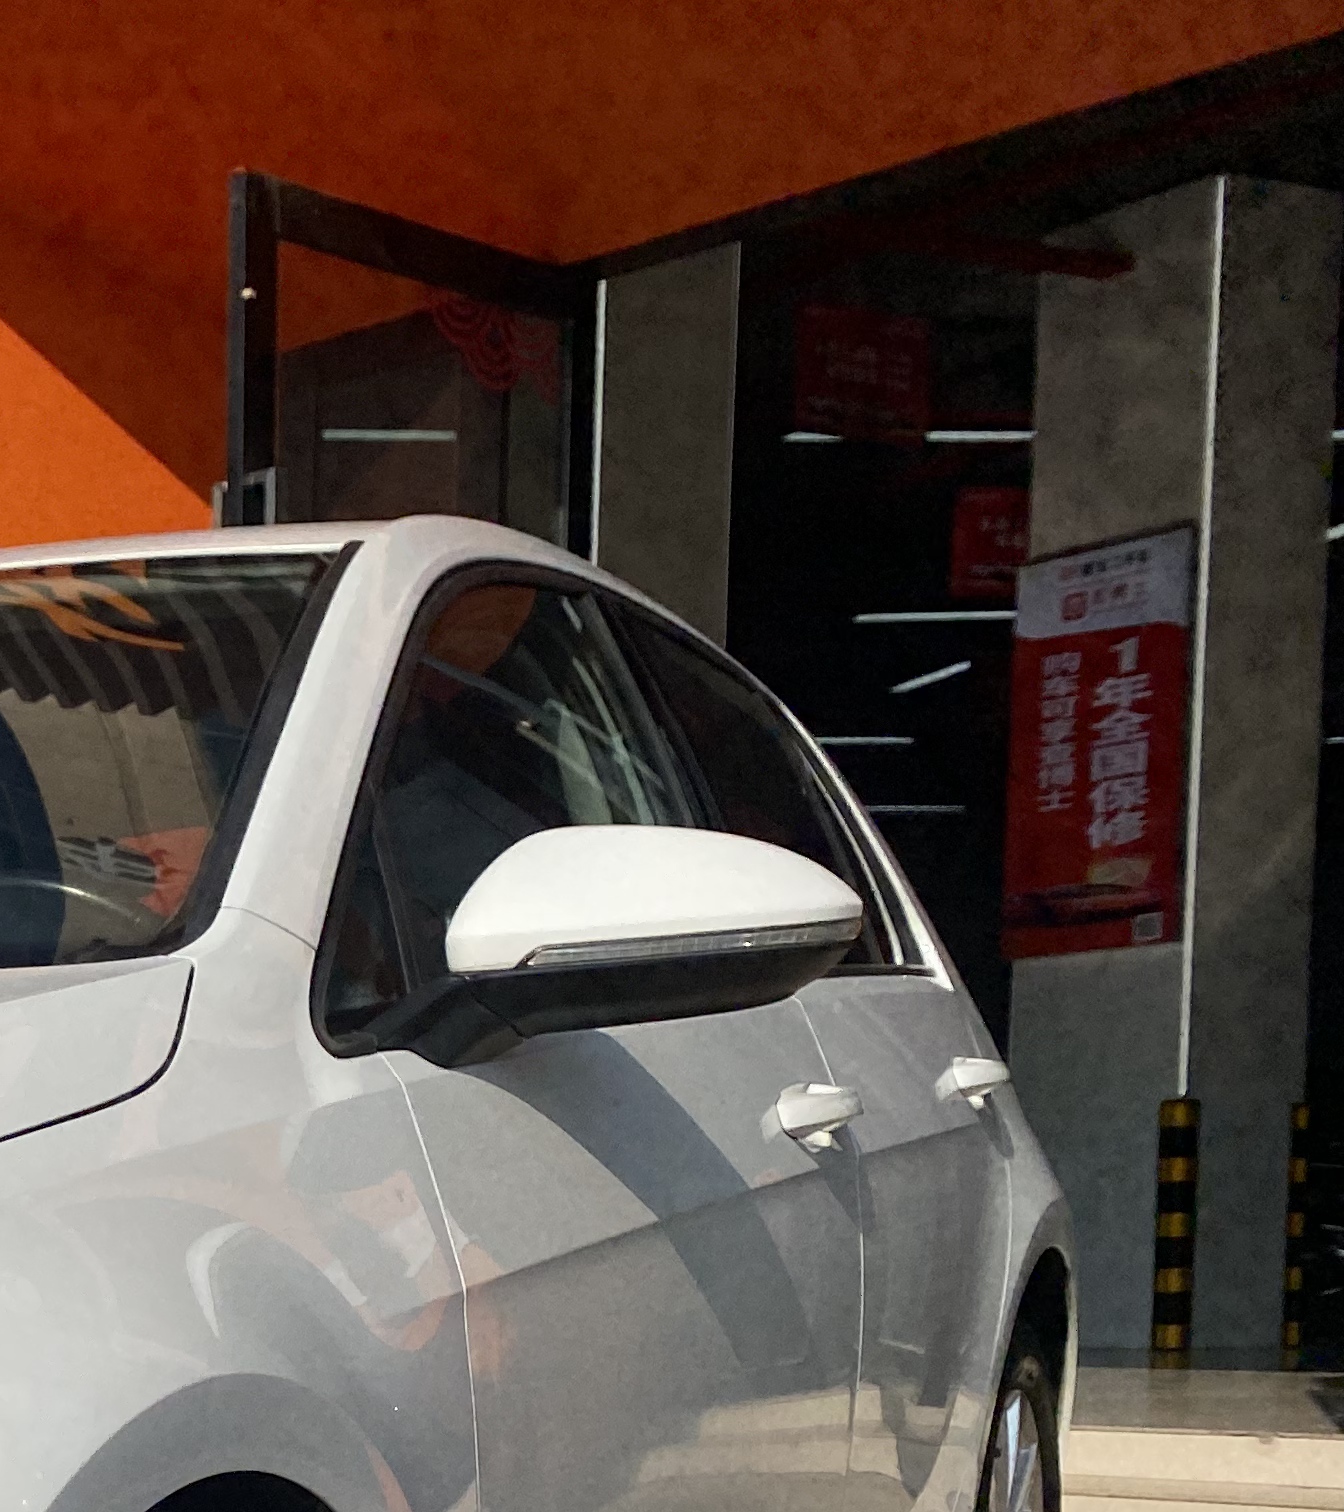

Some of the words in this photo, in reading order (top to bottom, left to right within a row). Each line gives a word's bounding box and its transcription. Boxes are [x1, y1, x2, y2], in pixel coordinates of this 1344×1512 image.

[1086, 635, 1154, 849] 1年全国保修
